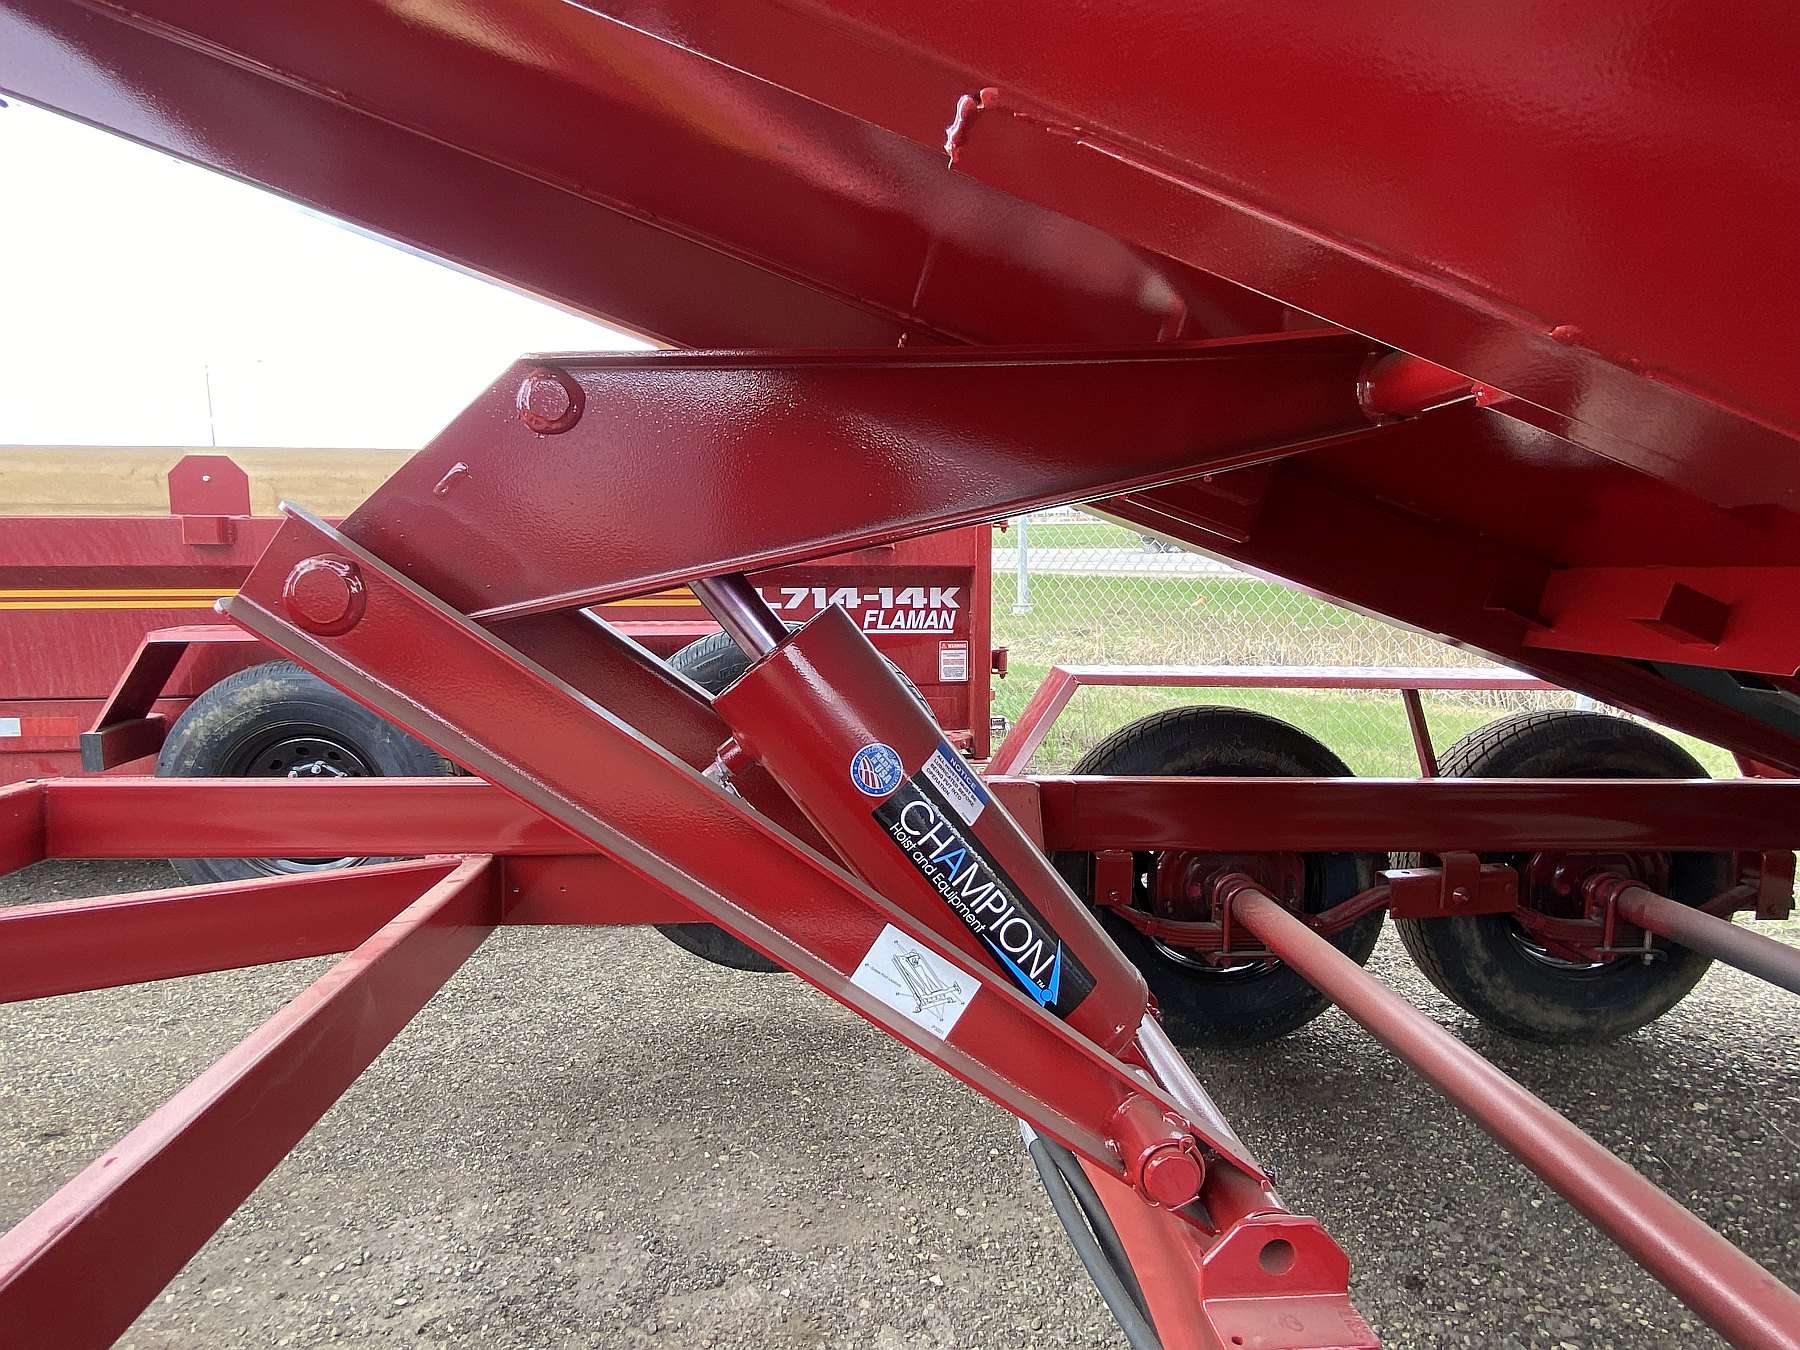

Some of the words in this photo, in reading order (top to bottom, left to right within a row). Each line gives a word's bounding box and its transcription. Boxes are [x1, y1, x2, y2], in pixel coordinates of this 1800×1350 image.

[863, 610, 956, 630] FLAMAN
[873, 762, 892, 784] USA
[874, 751, 892, 772] MADE
[948, 757, 977, 790] NOTICE
[888, 822, 916, 852] Hoist
[911, 849, 936, 876] and
[931, 873, 985, 933] Equipment
[900, 802, 1055, 979] CHAMPION
